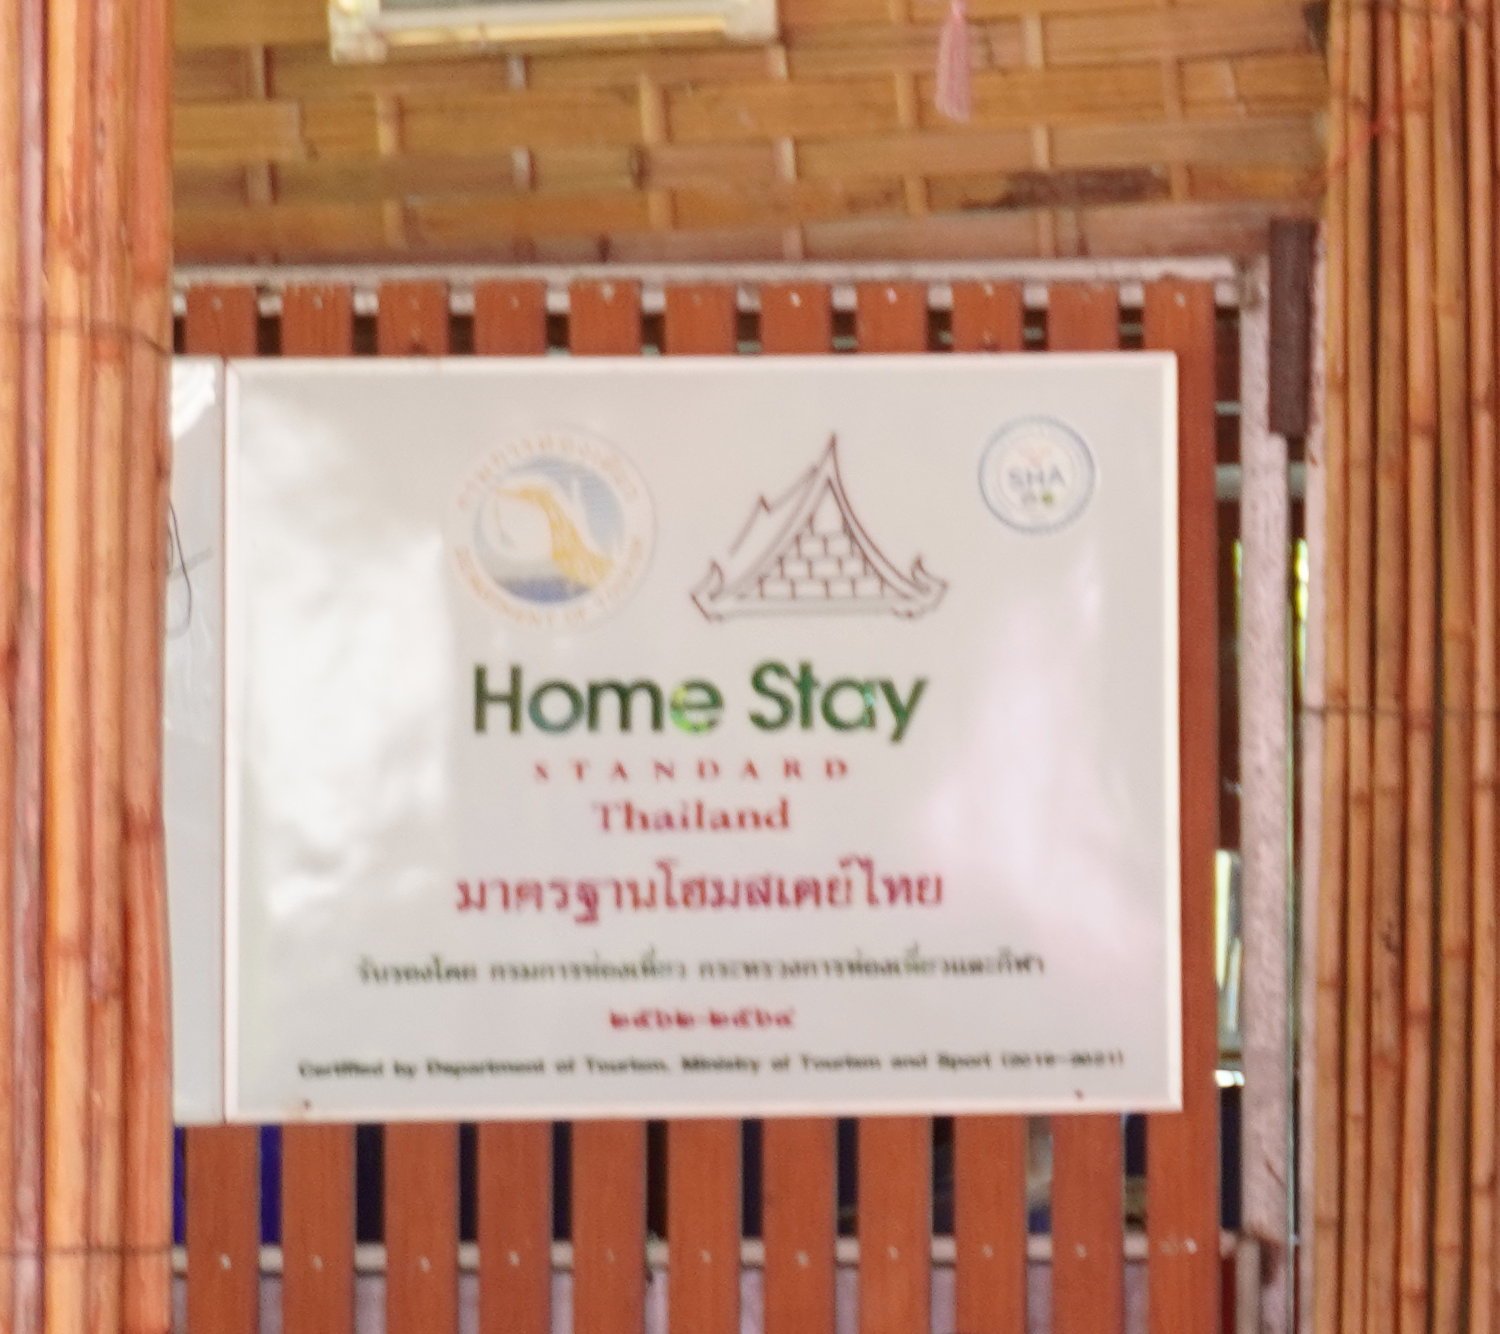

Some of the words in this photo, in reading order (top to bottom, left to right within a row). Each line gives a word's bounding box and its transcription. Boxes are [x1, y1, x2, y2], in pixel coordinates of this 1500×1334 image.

[473, 663, 724, 734] Home
[748, 661, 928, 745] Stay
[534, 758, 849, 782] STANDARD
[592, 798, 791, 833] Thailand
[455, 855, 944, 926] มาตรฐานโฮมสเตย์ไทย
